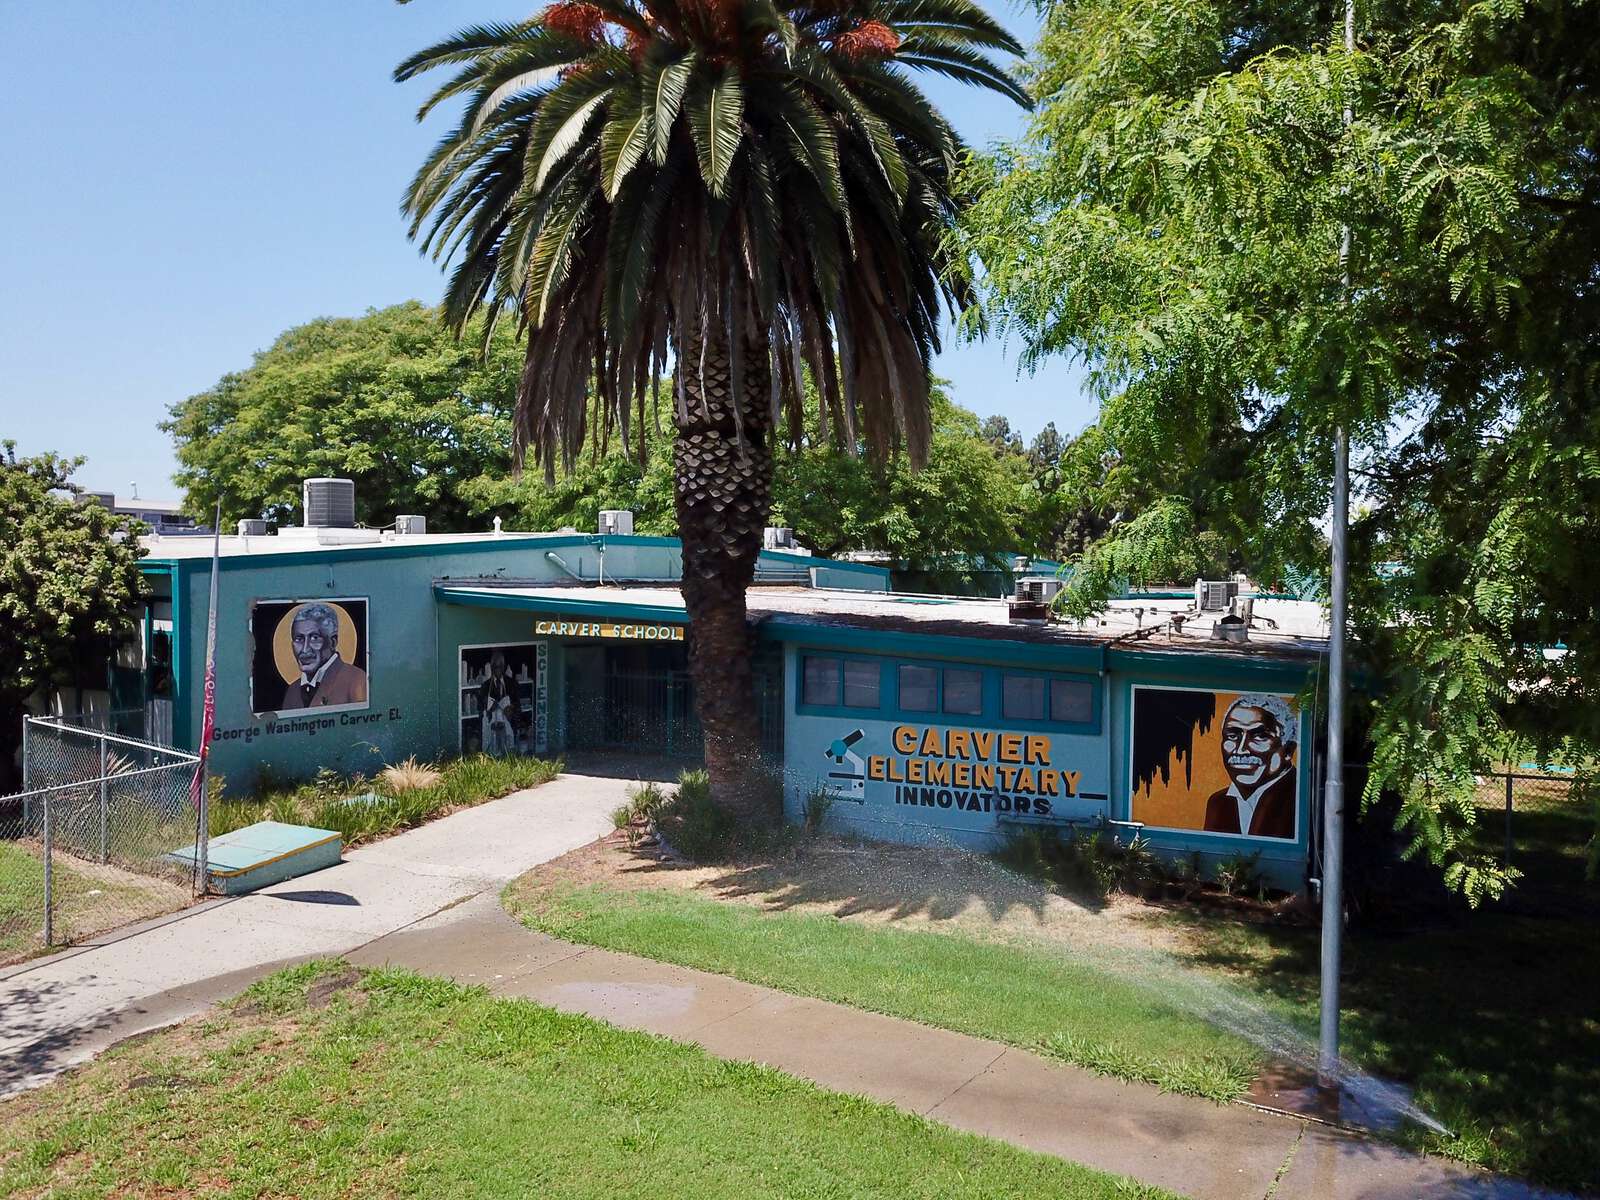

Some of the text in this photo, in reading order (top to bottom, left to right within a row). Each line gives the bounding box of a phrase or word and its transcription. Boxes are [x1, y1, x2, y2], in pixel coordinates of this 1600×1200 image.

[537, 621, 680, 640] CARVER SCHOOL
[537, 643, 547, 745] SCIENCE
[212, 726, 260, 743] George
[265, 717, 336, 735] Washington
[340, 711, 382, 726] Carver
[893, 726, 1050, 765] CARVER
[868, 755, 1081, 797] ELEMENTARY
[896, 786, 1051, 815] INNOVATORS
